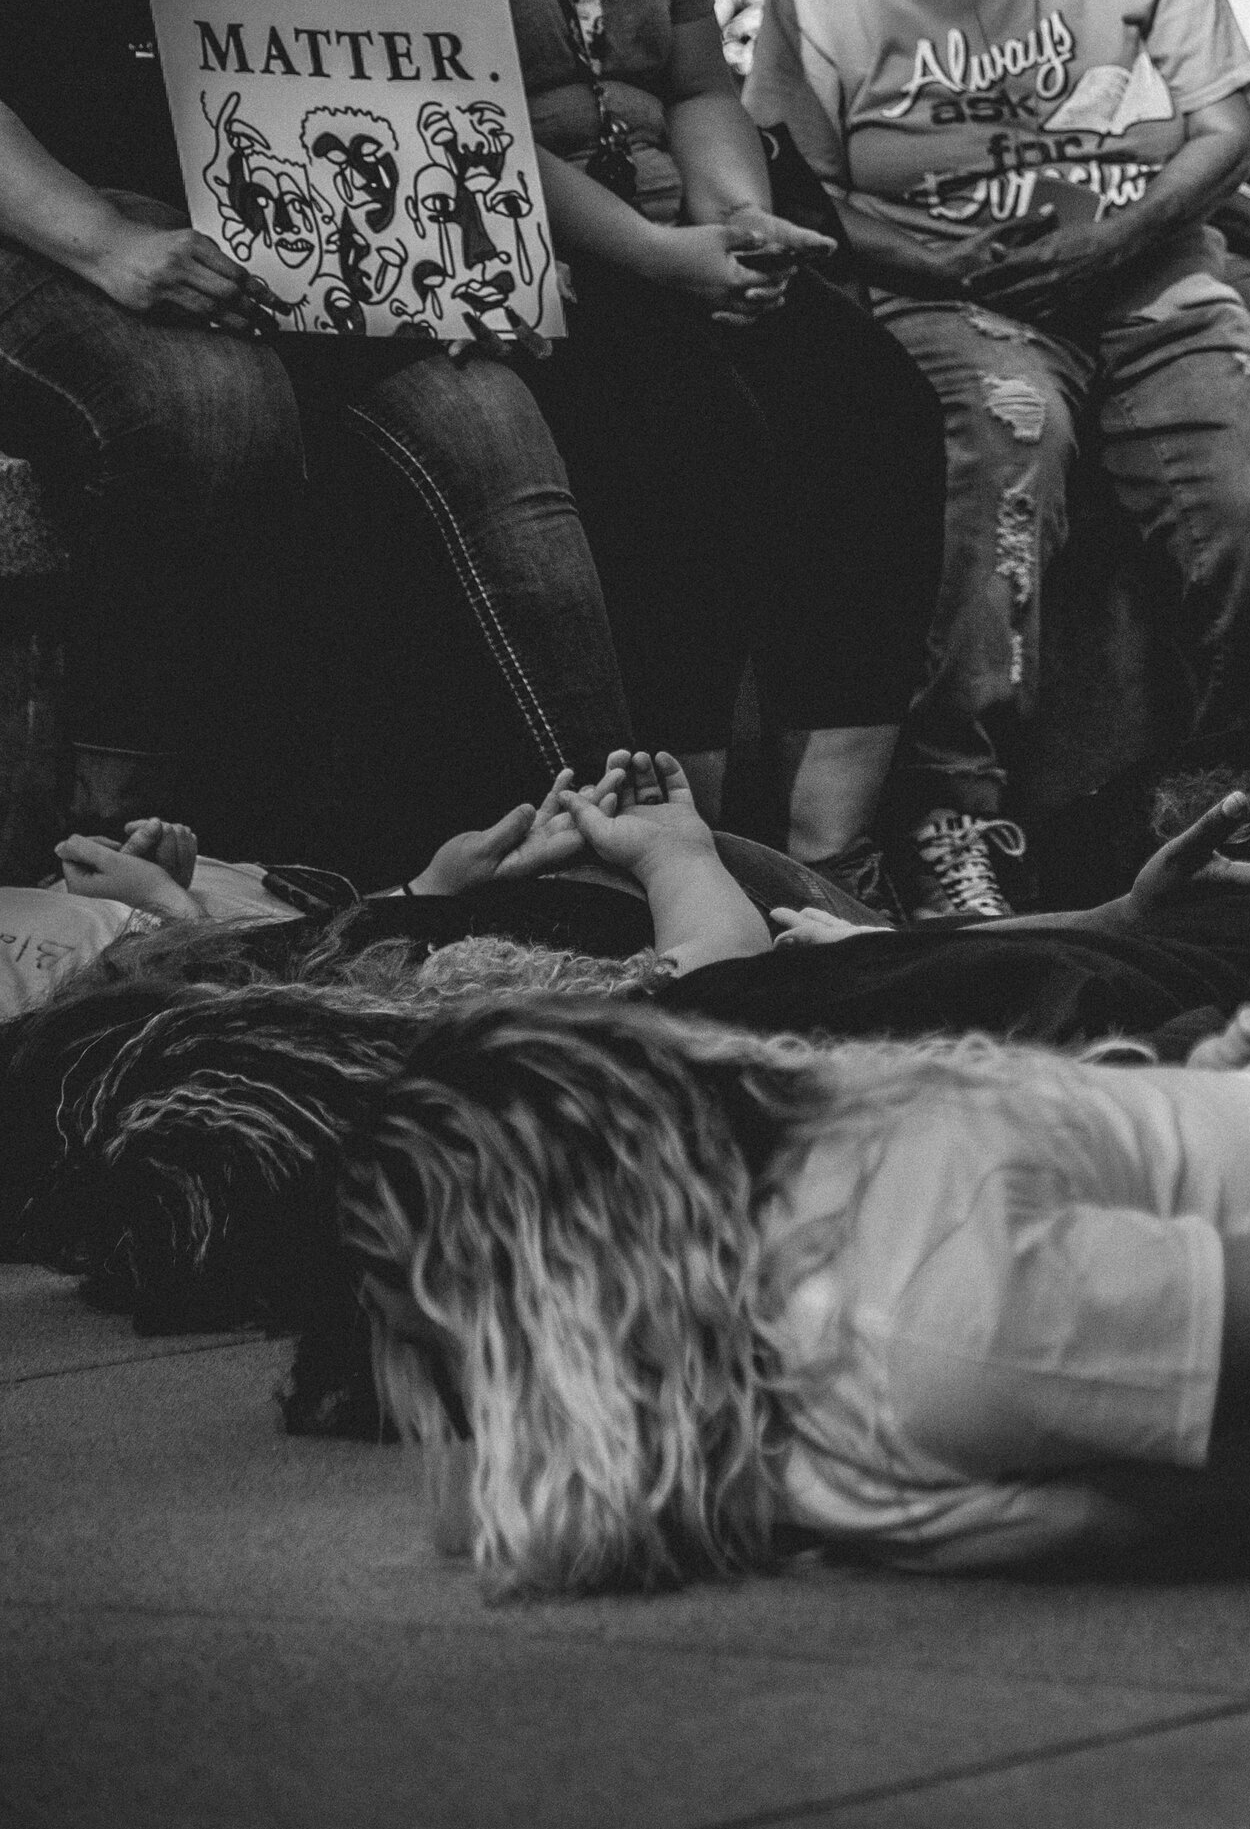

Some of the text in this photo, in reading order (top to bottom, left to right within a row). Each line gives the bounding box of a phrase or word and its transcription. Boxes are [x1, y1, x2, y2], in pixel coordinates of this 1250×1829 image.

[192, 19, 501, 84] MATTER.
[882, 10, 1075, 118] Always
[930, 92, 1038, 124] ask
[988, 133, 1084, 174] for
